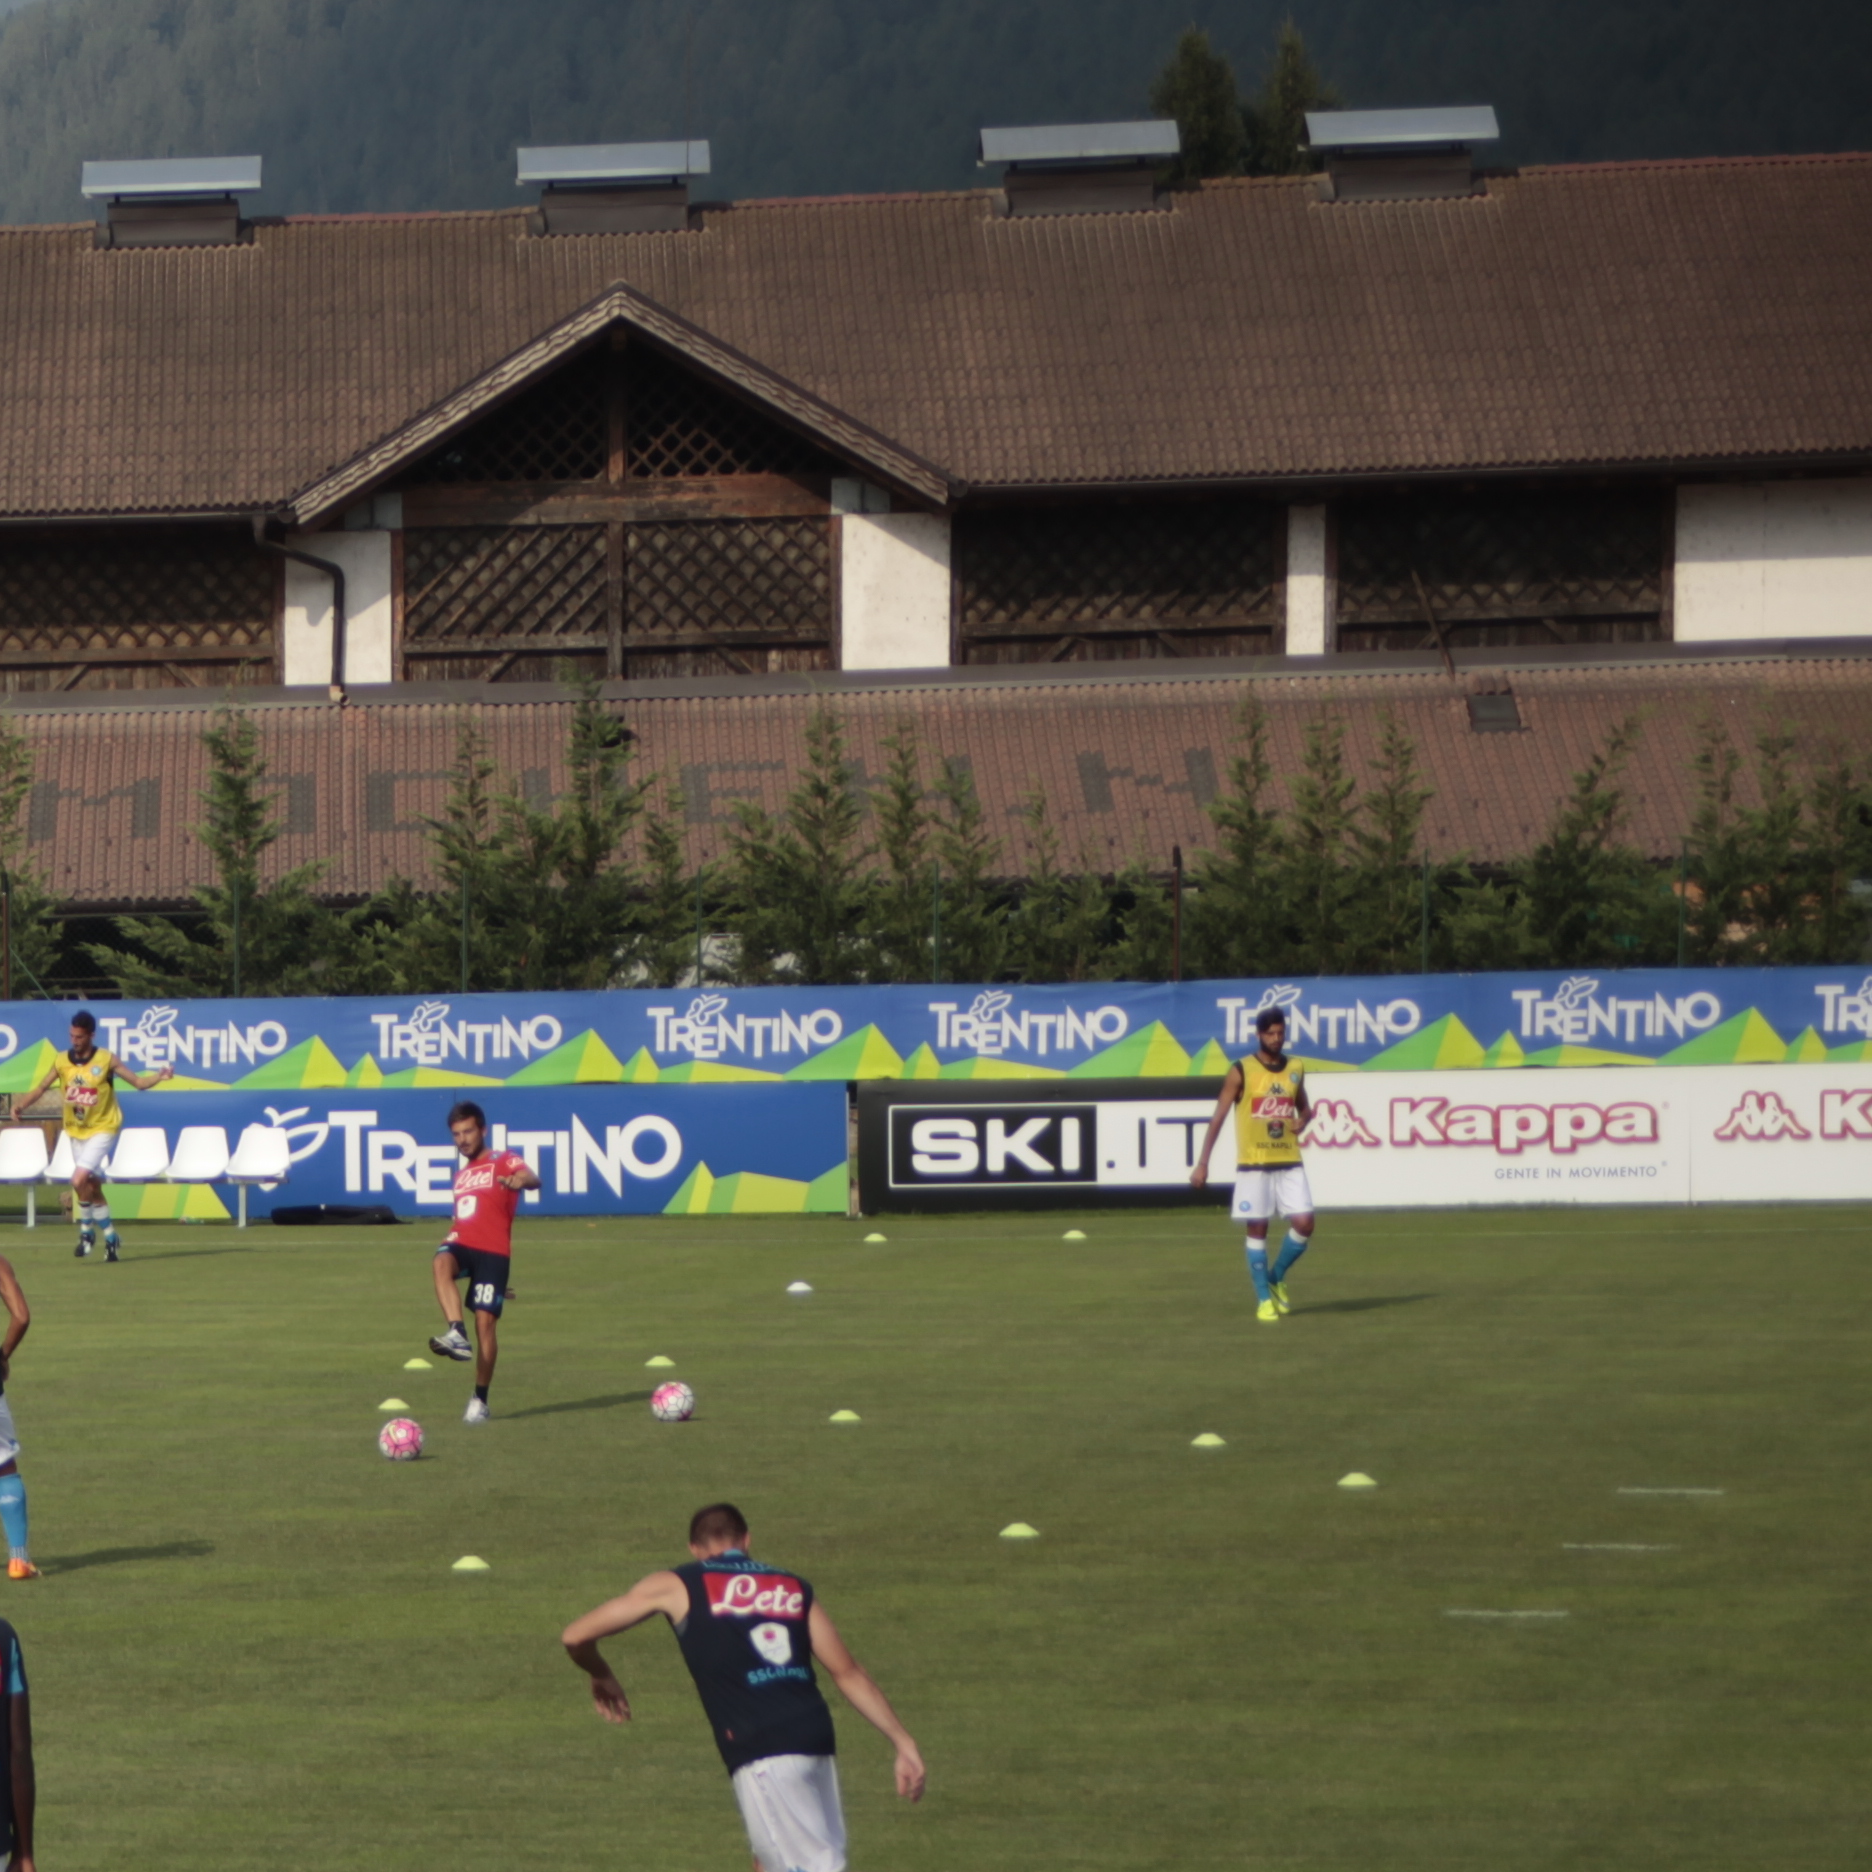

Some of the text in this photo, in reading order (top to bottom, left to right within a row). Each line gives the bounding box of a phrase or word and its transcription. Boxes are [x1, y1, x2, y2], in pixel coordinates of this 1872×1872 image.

[371, 1014, 563, 1064] TRENTINO
[647, 1007, 842, 1059] TRENTINO
[929, 1002, 1128, 1055] TRENTINO
[1512, 990, 1720, 1043] TRENTINO
[99, 1018, 288, 1068] TRENTINO
[1390, 1096, 1659, 1155] Kappa
[328, 1109, 683, 1205] TRETINO
[1494, 1165, 1657, 1180] GENTE IN MOVIMENTO
[711, 1574, 803, 1615] Lete
